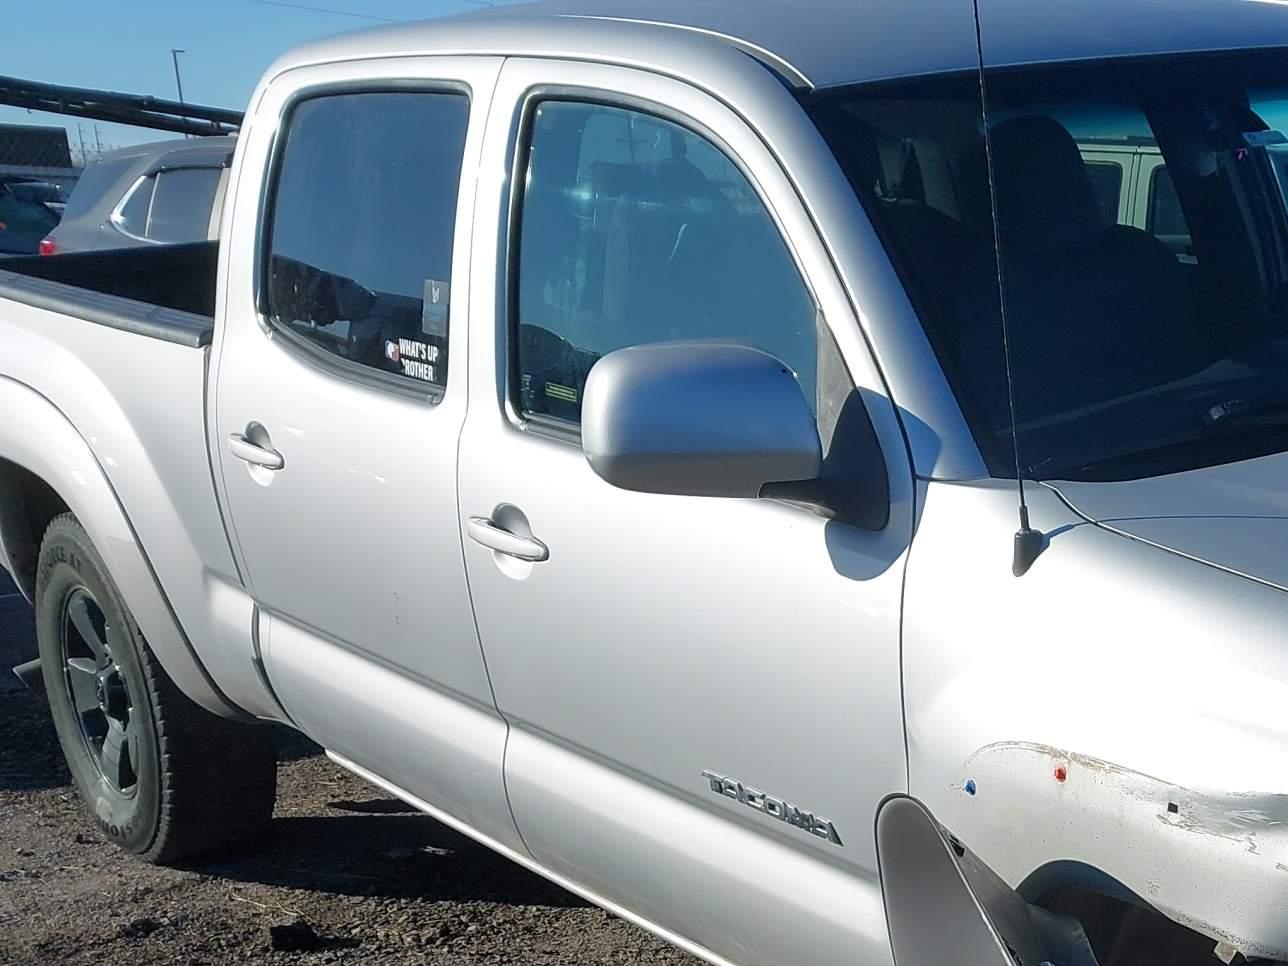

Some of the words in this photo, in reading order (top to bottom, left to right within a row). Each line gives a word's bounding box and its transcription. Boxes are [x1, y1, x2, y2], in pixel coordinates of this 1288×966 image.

[399, 338, 427, 360] WHAT'S
[427, 344, 439, 362] UP
[701, 770, 844, 847] TACOMA
